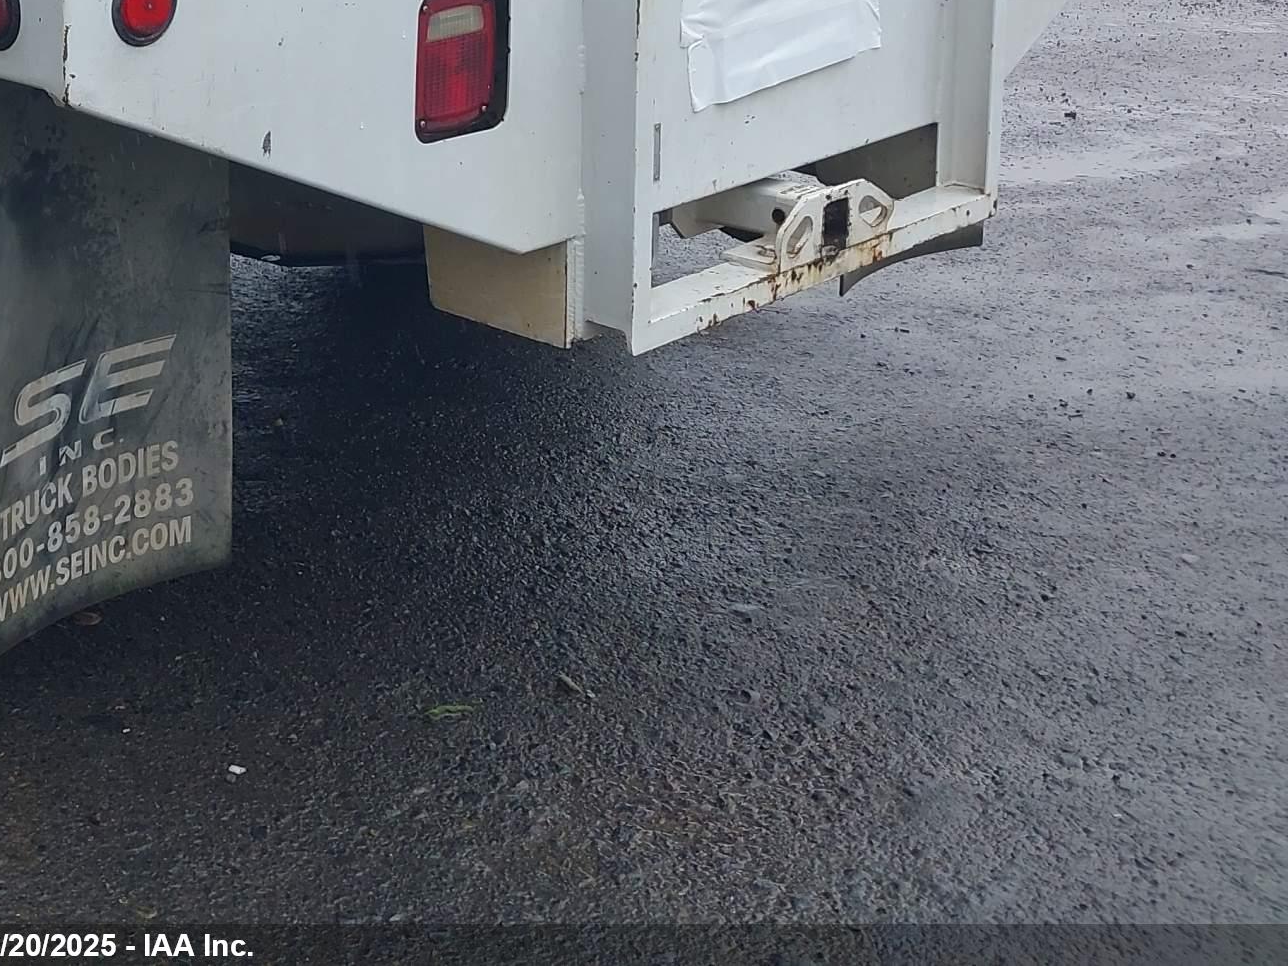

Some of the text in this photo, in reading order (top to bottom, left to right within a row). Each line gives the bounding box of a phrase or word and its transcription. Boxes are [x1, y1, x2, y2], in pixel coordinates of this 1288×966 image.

[0, 334, 176, 468] SE
[0, 440, 178, 540] TRUCK BODIES
